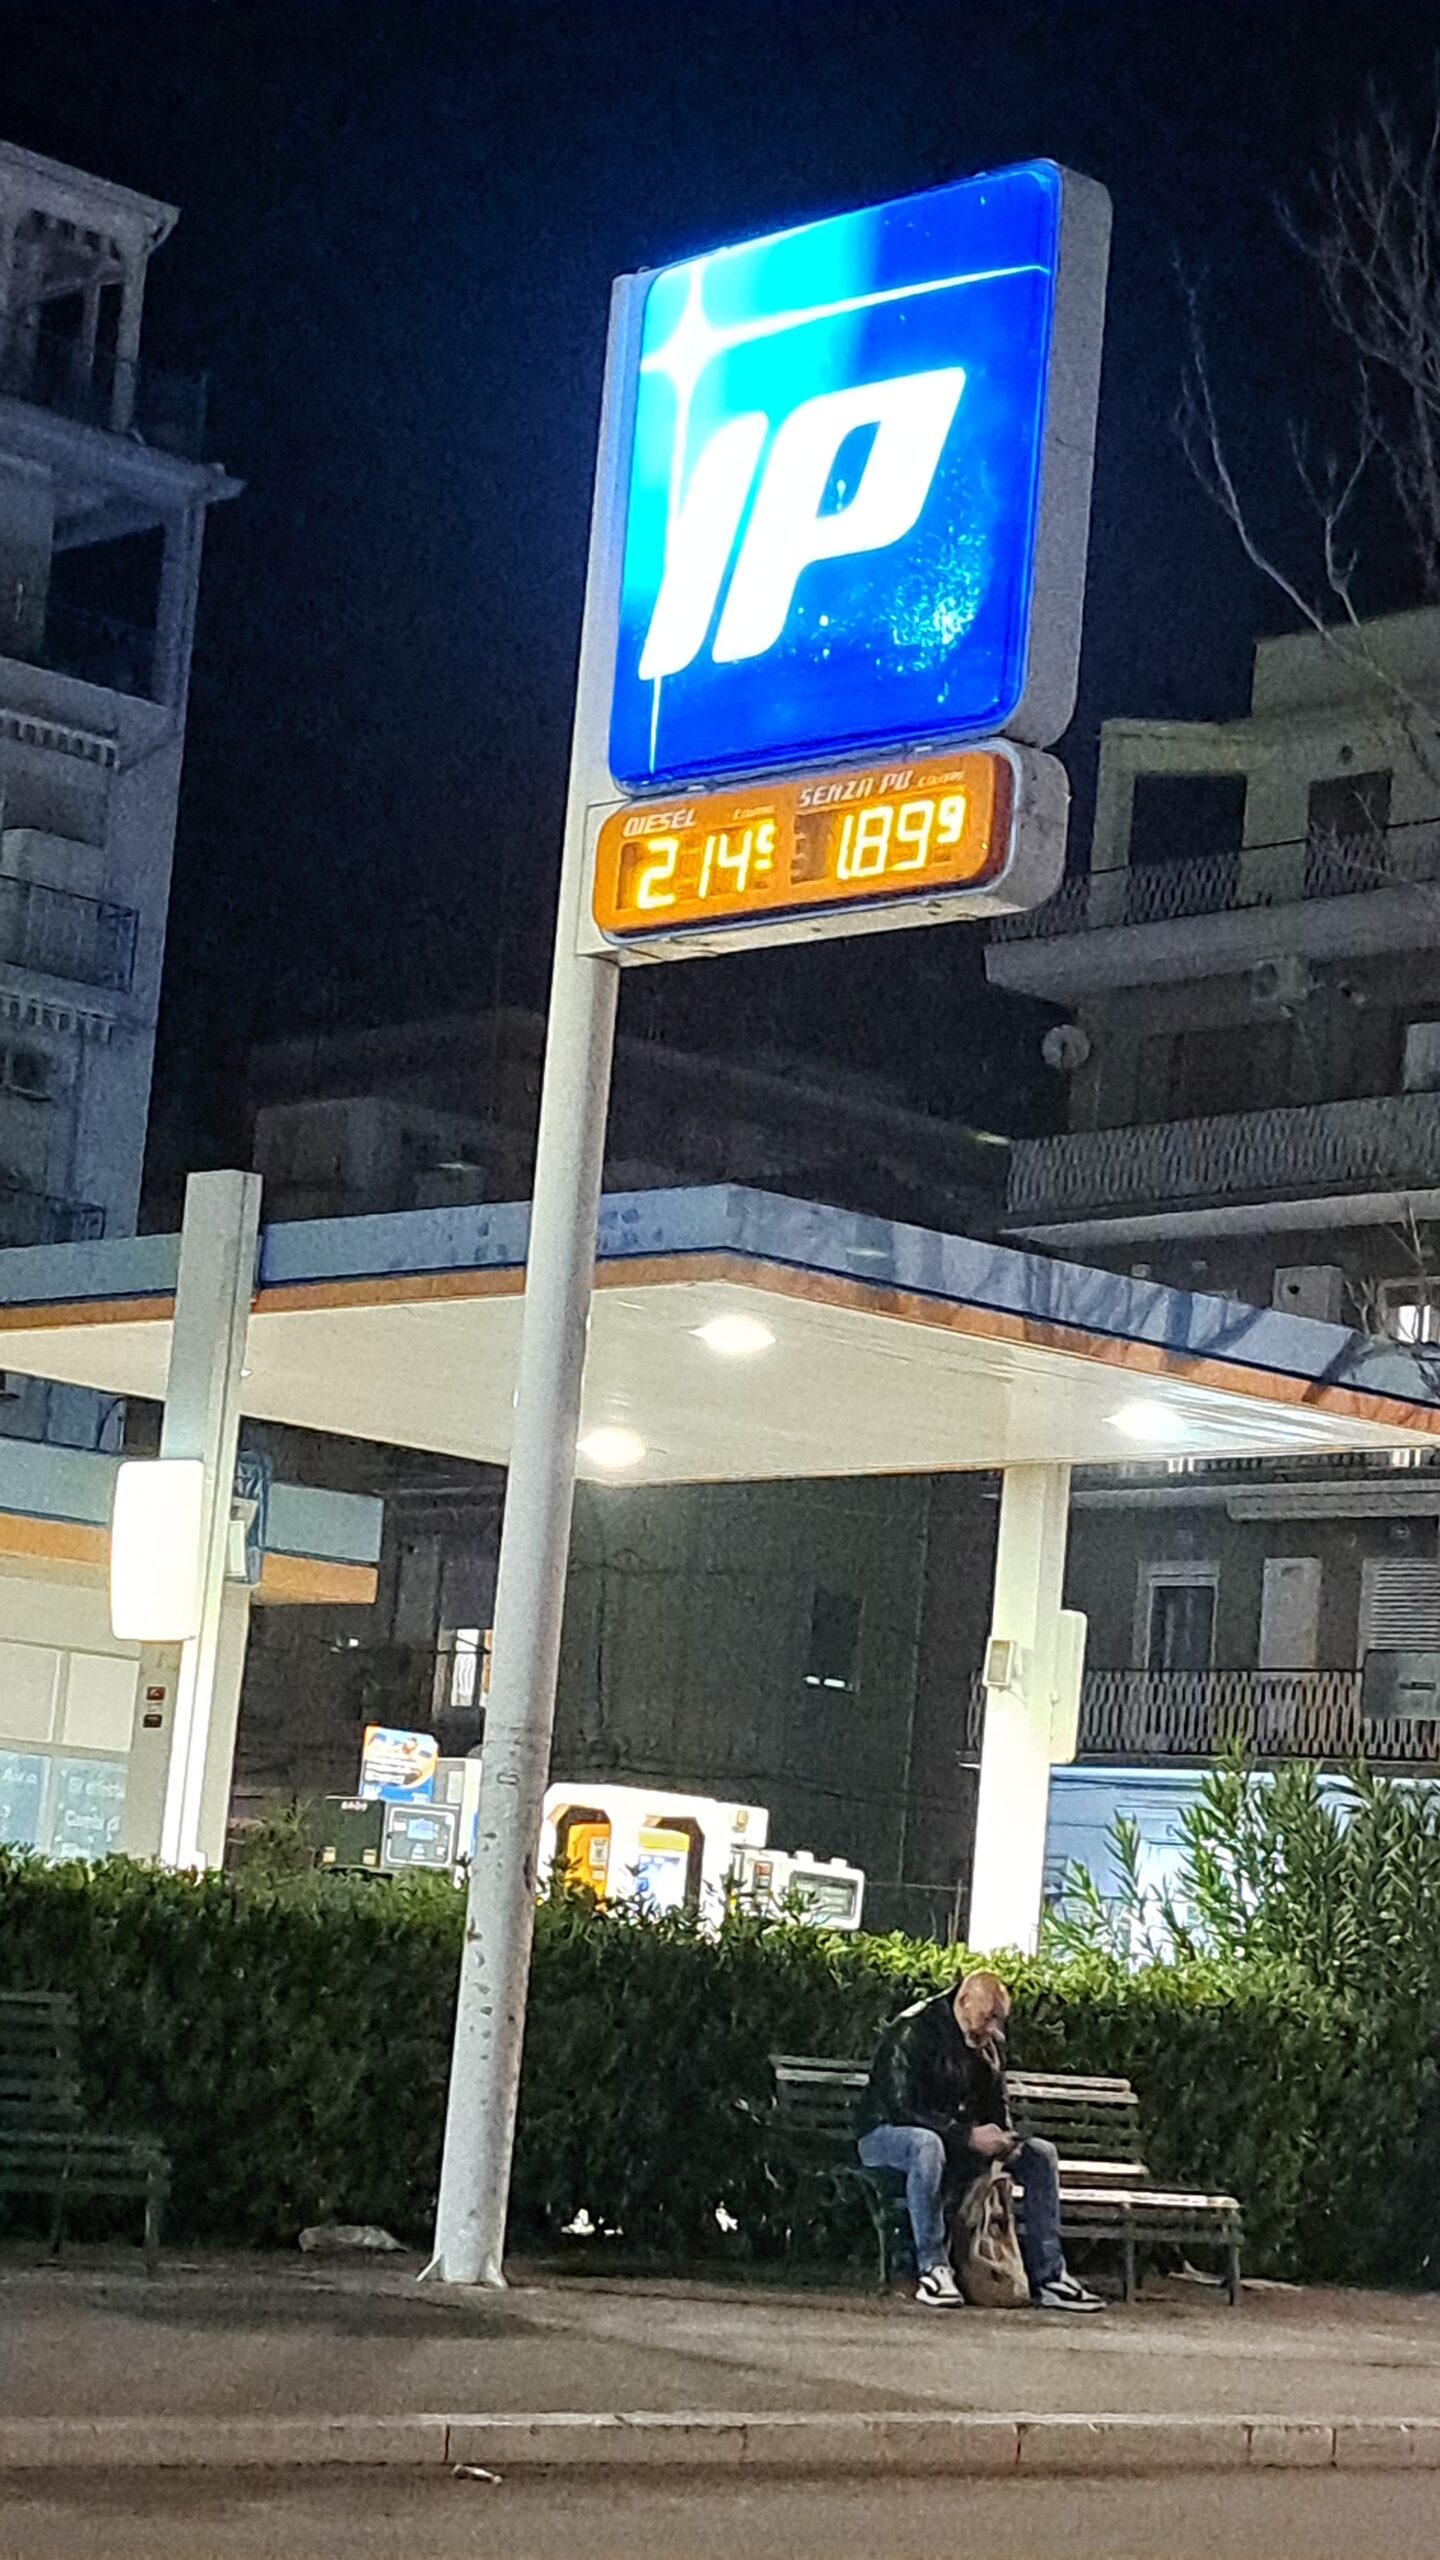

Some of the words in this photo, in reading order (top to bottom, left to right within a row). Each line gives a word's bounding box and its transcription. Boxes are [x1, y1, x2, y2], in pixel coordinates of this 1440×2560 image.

[639, 366, 966, 681] IP
[799, 777, 875, 808] SENZA
[623, 808, 696, 837] DIESEL
